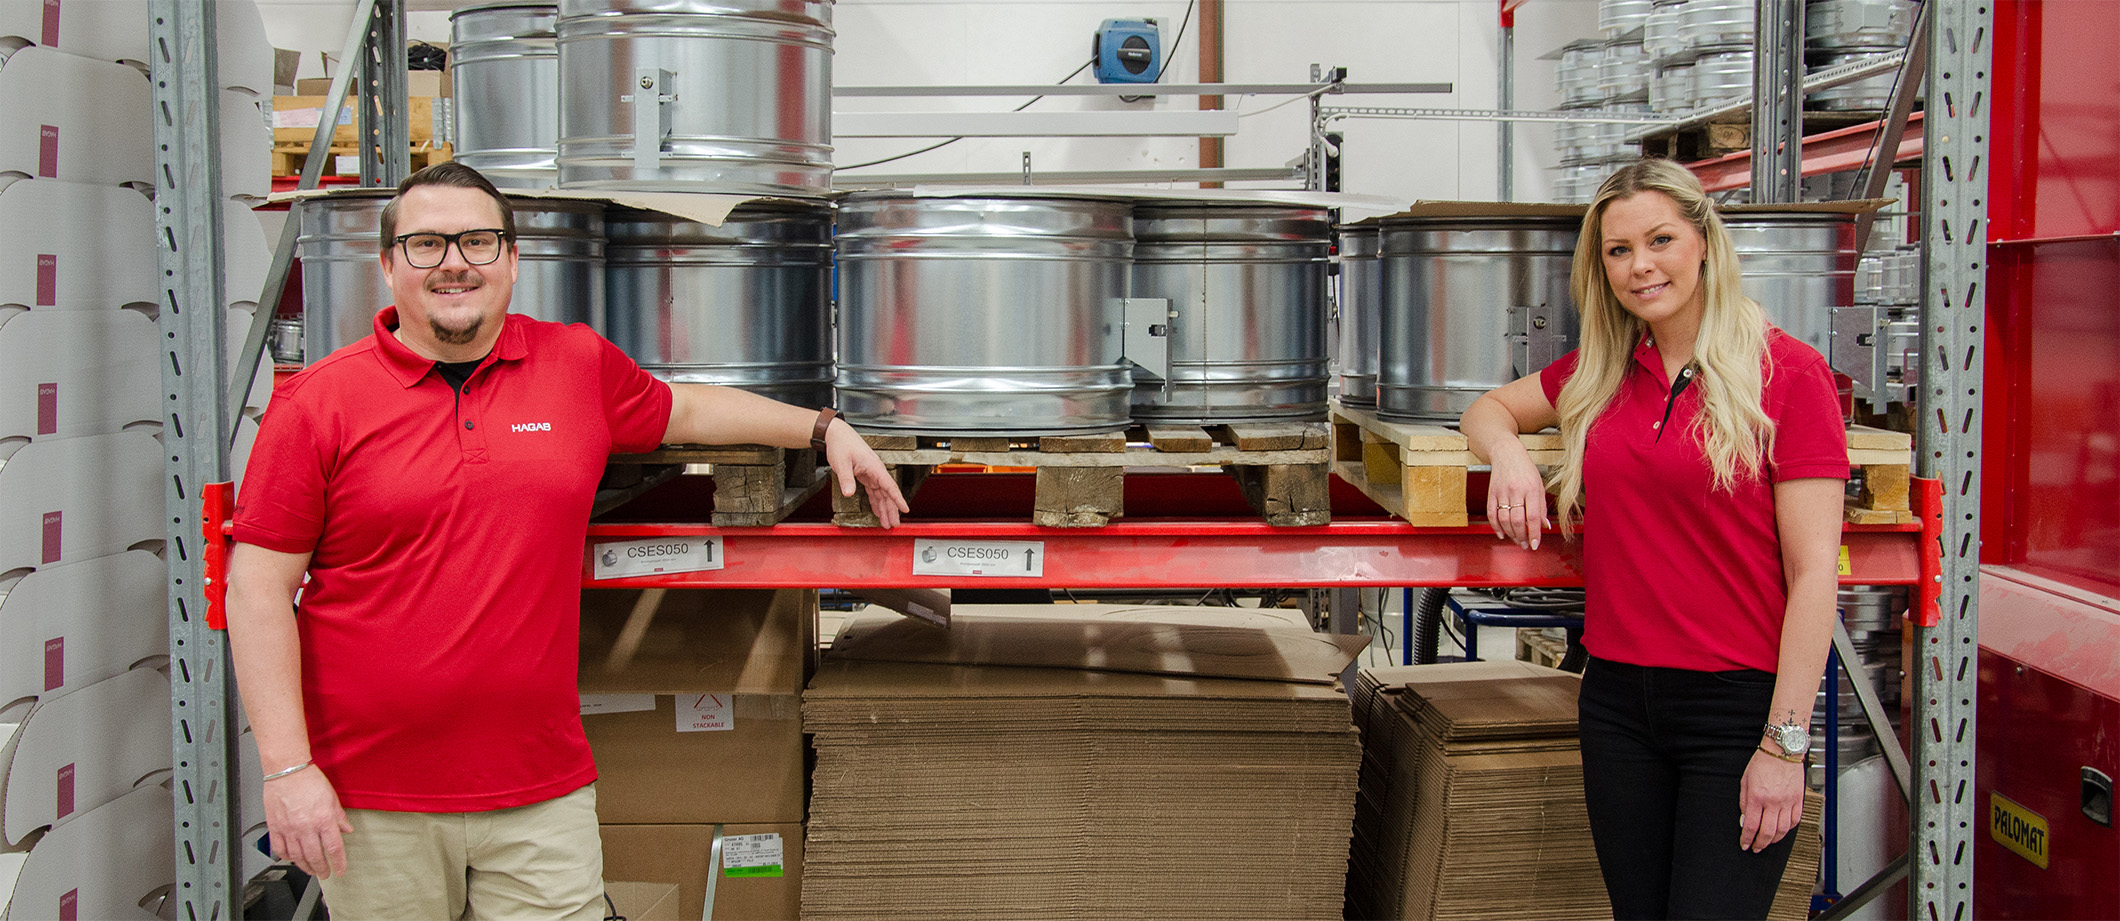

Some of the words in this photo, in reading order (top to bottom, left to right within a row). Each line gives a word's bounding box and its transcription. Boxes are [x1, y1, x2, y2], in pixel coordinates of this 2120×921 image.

[511, 422, 551, 432] HAGAB
[627, 543, 688, 558] CSES050
[947, 546, 1009, 559] CSES050
[1995, 805, 2044, 856] PALOMAT
